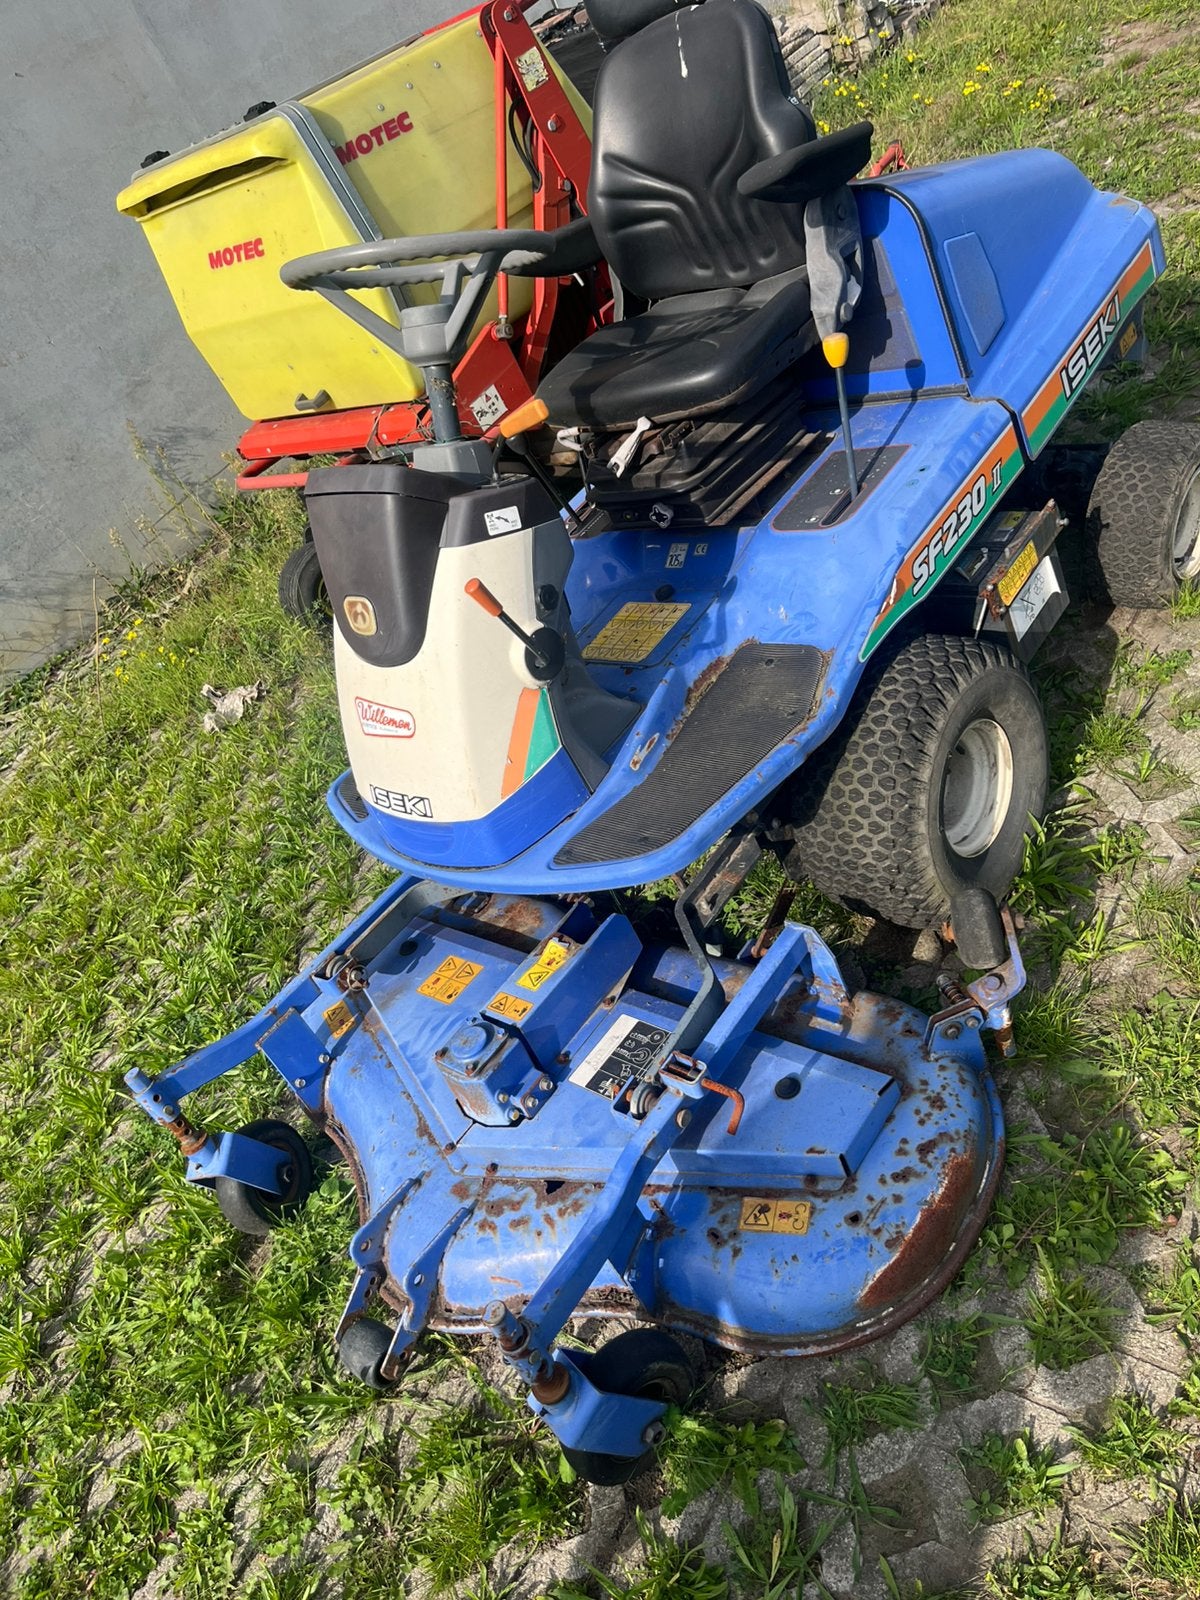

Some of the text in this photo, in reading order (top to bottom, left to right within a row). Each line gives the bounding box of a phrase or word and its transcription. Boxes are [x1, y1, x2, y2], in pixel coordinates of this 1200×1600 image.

[336, 111, 414, 166] MOTEC
[208, 238, 265, 270] MOTEC
[1060, 290, 1120, 401] ISEKI
[912, 473, 986, 597] SF230
[369, 783, 433, 818] ISEKI
